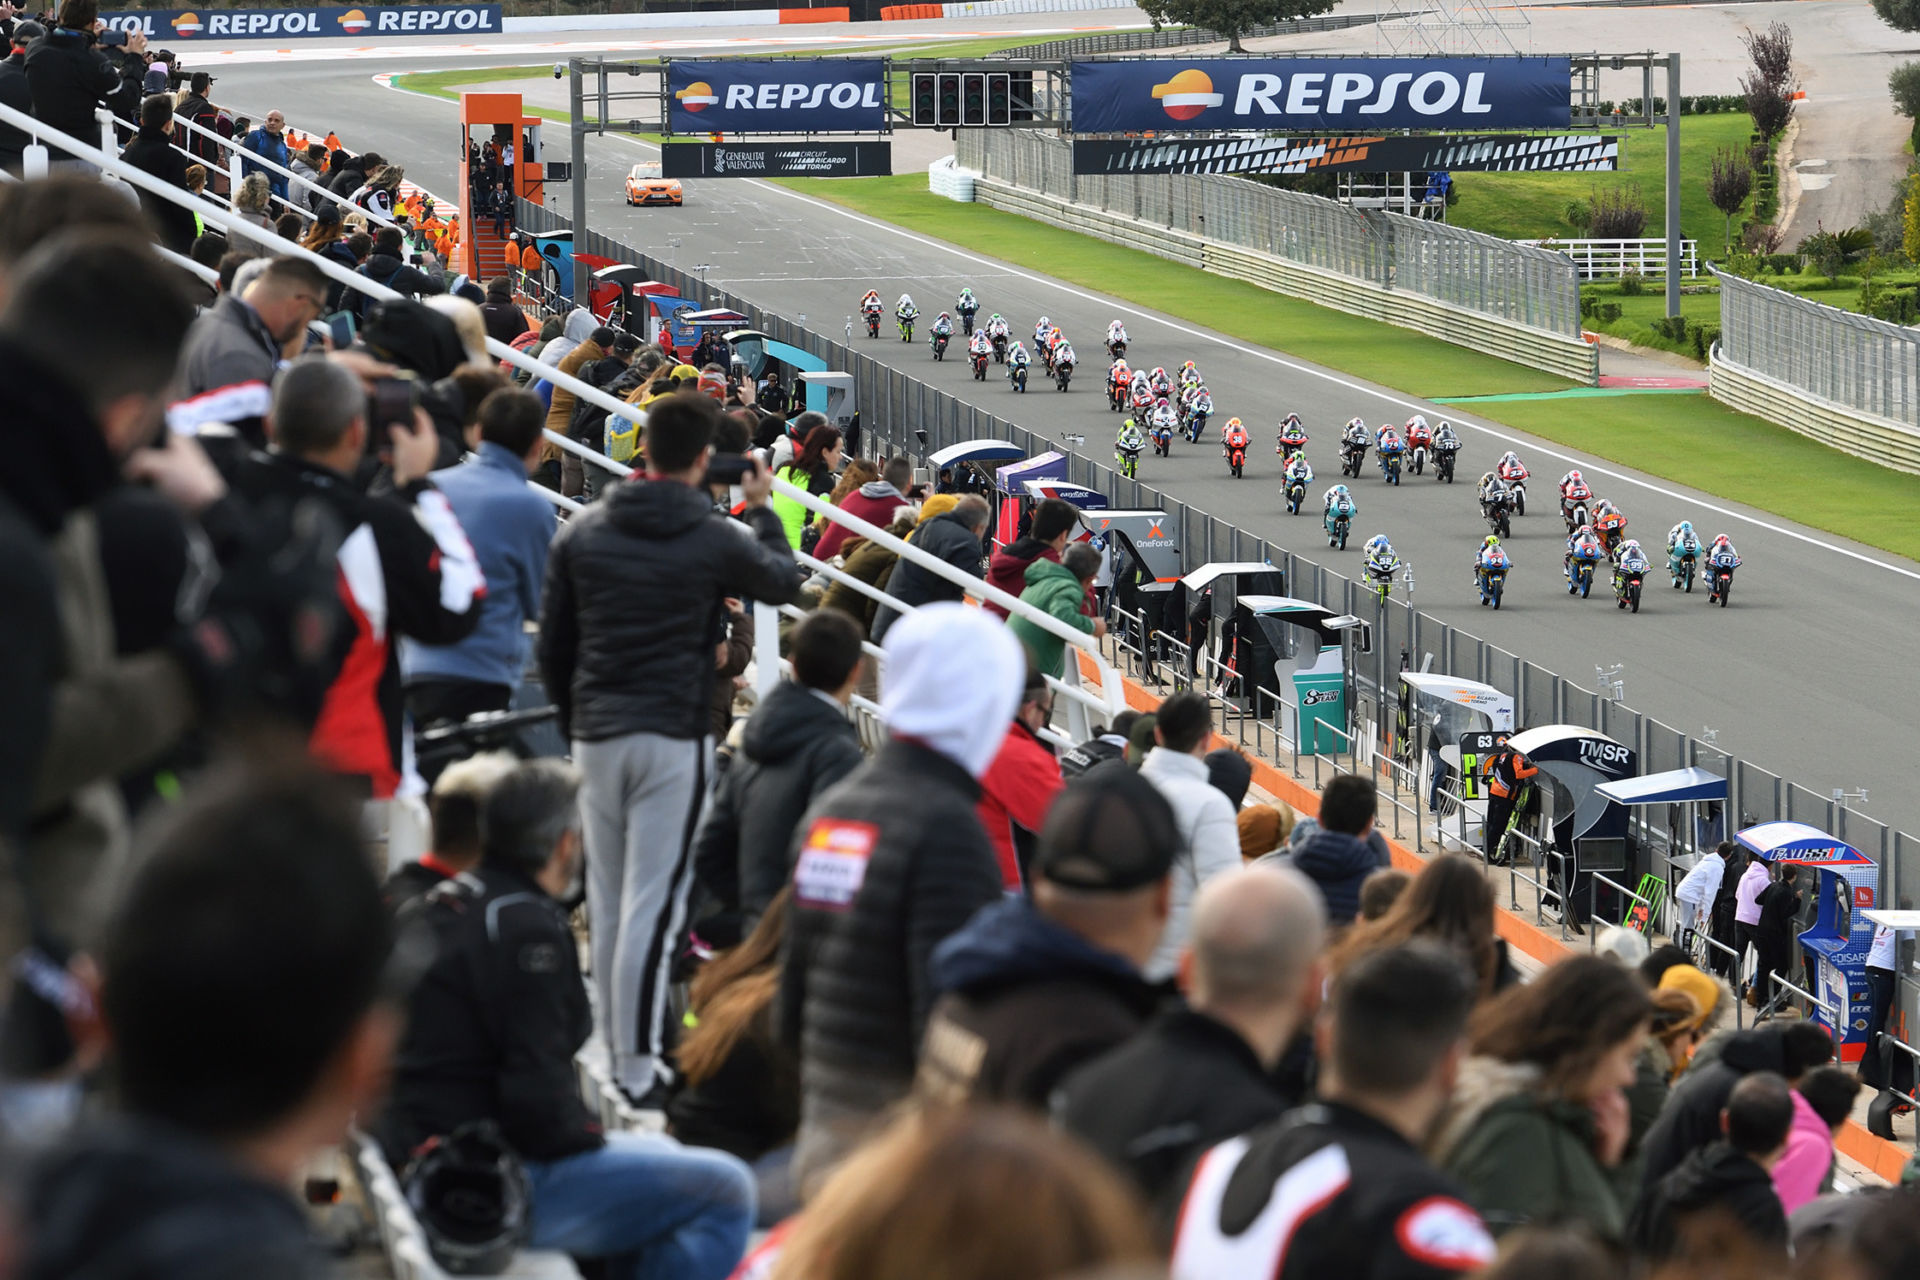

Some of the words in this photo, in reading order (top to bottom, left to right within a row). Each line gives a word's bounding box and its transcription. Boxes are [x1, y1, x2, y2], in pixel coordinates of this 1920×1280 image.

[209, 13, 320, 34] REPSOL
[378, 9, 492, 30] REPSOL
[725, 82, 880, 109] REPSOL
[1234, 71, 1492, 115] REPSOL
[725, 151, 765, 160] GENERALITAT
[726, 160, 766, 169] VALENCIANA
[1136, 539, 1175, 548] OneForeX
[1491, 557, 1503, 565] 96
[1477, 735, 1493, 748] 63
[1578, 739, 1629, 763] TMSR
[1463, 753, 1477, 775] P
[1465, 777, 1478, 799] L
